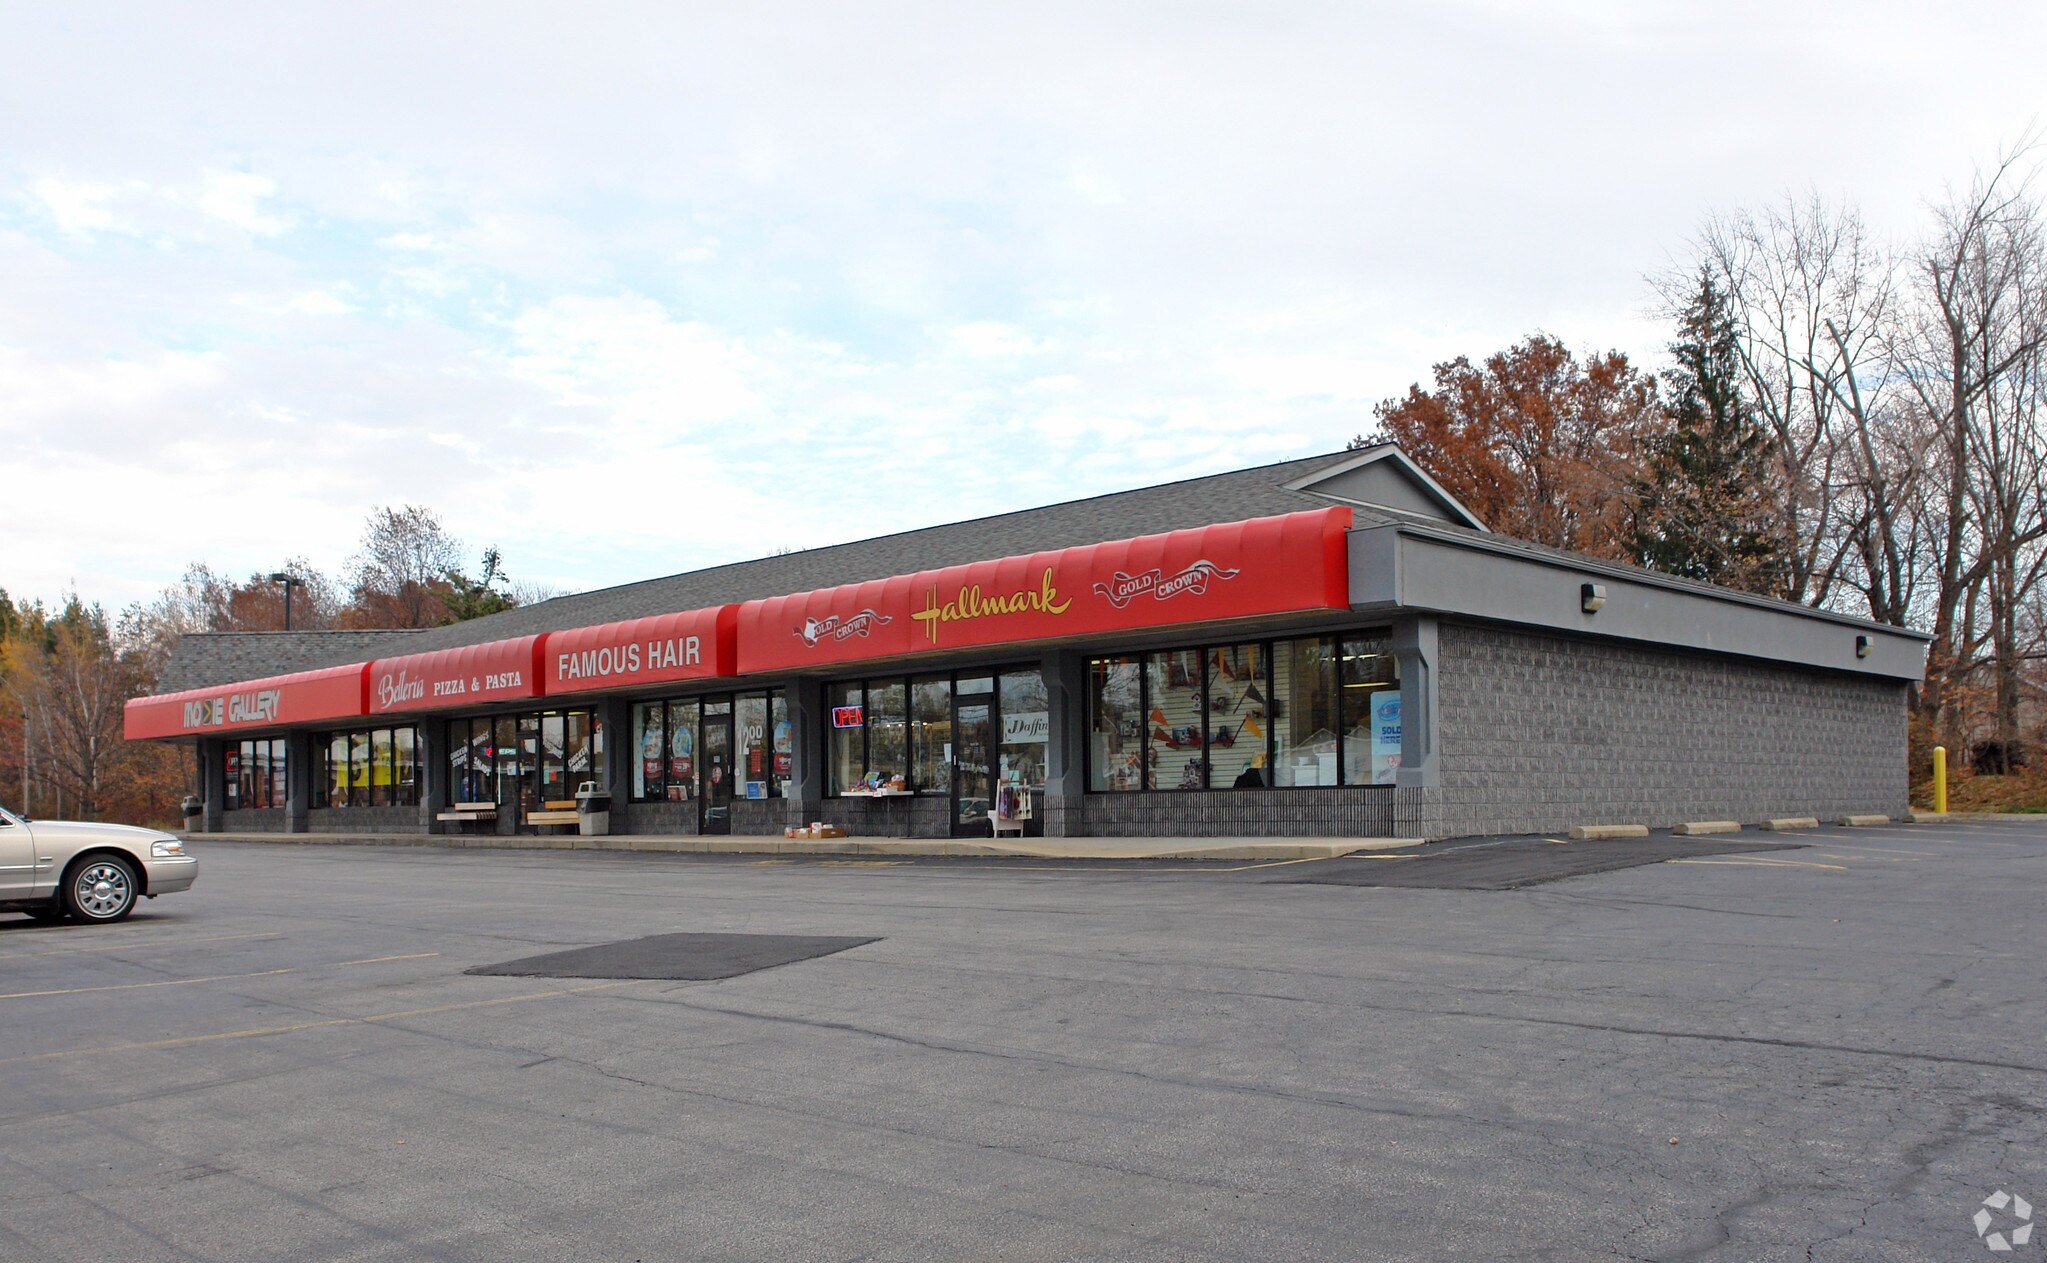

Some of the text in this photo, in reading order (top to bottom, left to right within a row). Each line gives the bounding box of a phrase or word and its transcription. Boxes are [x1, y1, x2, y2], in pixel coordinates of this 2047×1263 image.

[1118, 571, 1202, 597] GOLD CROWN
[911, 566, 1073, 645] Hallmark
[813, 617, 867, 639] OLD CROWN
[558, 635, 701, 681] FAMOUS HAIR
[377, 670, 522, 709] Belleria PIZZA & PASTA
[228, 689, 281, 723] GALLERY
[1381, 735, 1401, 744] HERE
[1382, 726, 1402, 735] SOLD
